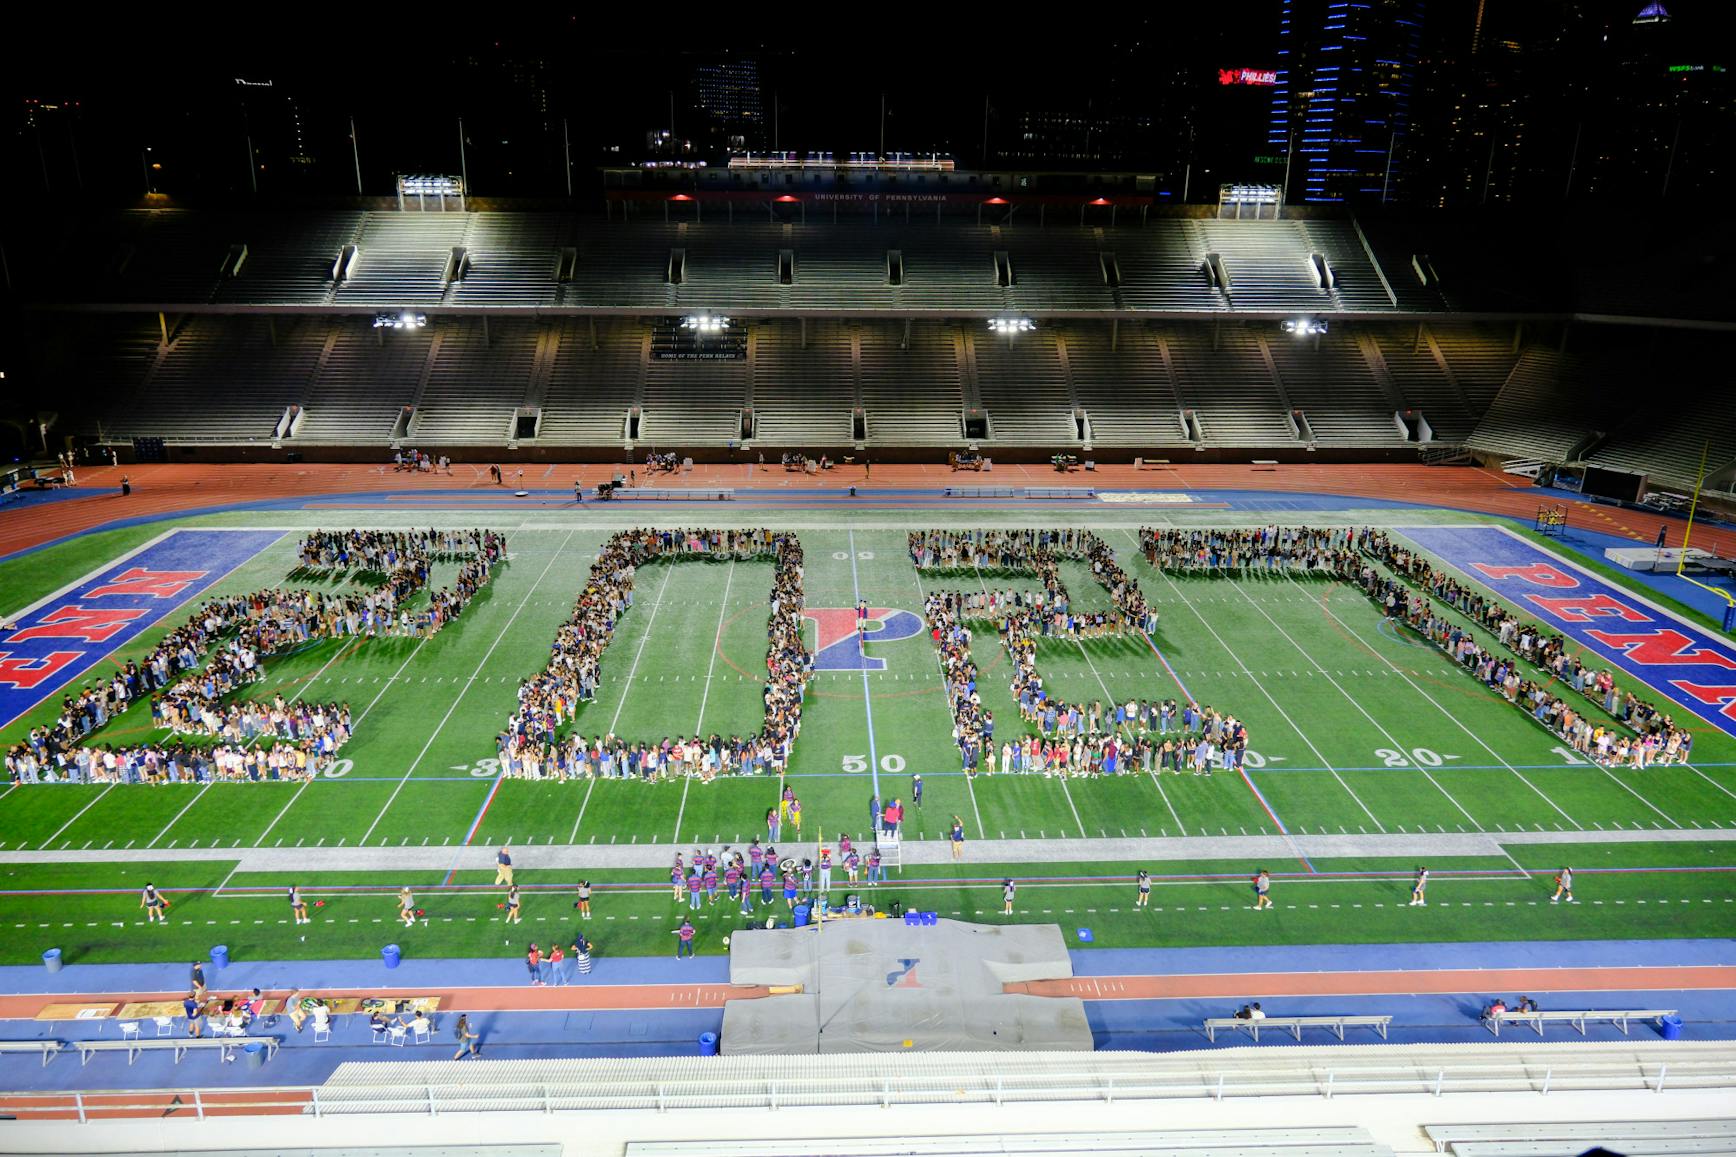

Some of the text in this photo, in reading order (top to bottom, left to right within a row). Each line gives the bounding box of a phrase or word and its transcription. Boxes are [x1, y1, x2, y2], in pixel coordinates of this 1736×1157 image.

[815, 193, 863, 201] UNIVERSITY
[885, 194, 947, 202] PENNSYLVANIA
[841, 754, 906, 773] 50
[1374, 748, 1443, 767] 20
